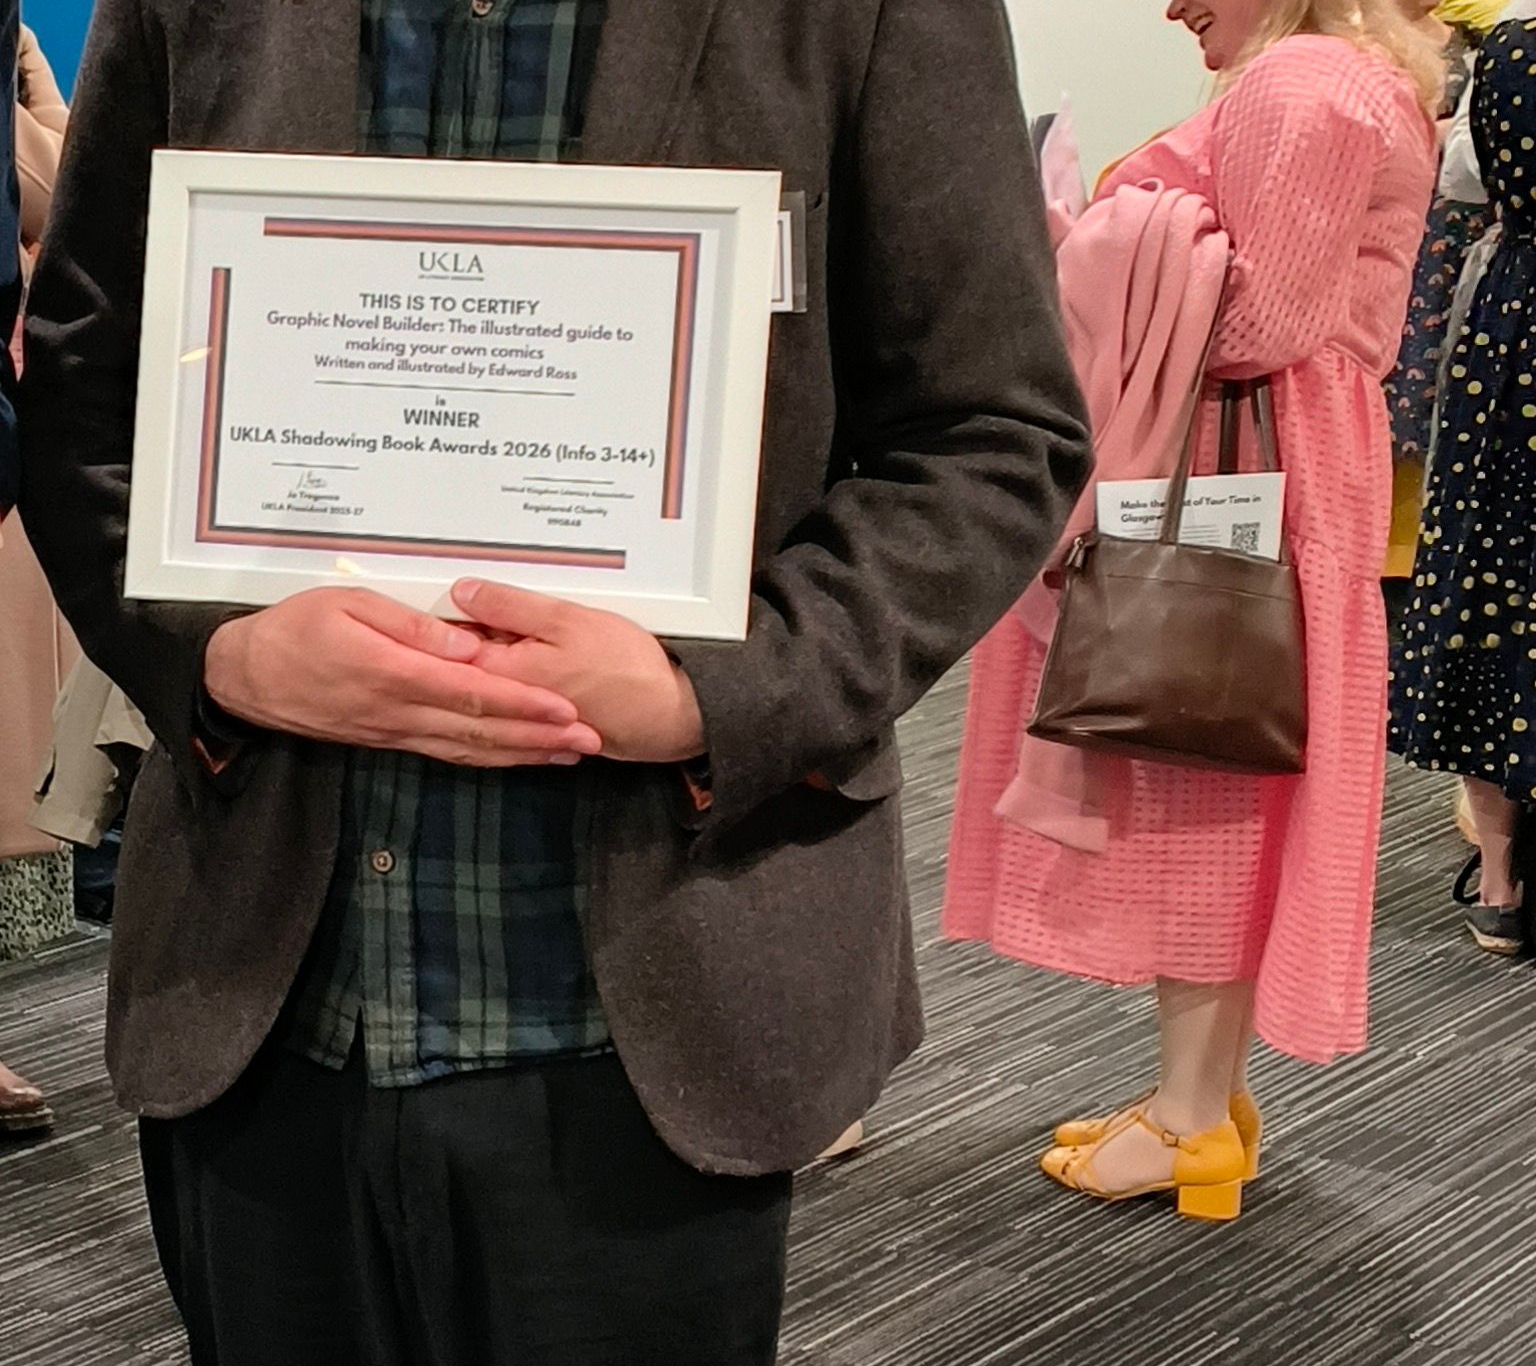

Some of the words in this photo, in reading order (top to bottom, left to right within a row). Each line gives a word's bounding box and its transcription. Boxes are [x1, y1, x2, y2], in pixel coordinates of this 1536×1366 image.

[419, 251, 484, 273] UKLA
[359, 293, 402, 310] THIS
[406, 295, 425, 312] IS
[430, 296, 456, 312] TO
[461, 297, 540, 316] CERTIFY
[267, 310, 330, 330] Graphic
[333, 313, 379, 330] Novel
[383, 316, 445, 333] Builder:
[448, 318, 477, 334] The
[480, 320, 563, 338] illustrated
[566, 325, 613, 343] guide
[616, 327, 634, 341] to
[345, 337, 406, 357] making
[409, 343, 447, 357] your
[450, 344, 487, 356] own
[490, 343, 545, 360] comics
[314, 354, 365, 370] Written
[367, 359, 394, 371] and
[397, 360, 465, 374] illustrated
[467, 362, 485, 379] by
[488, 363, 543, 379] Edward
[545, 366, 578, 380] Ross
[435, 395, 447, 407] is
[403, 408, 481, 428] WINNER
[229, 425, 276, 444] UKLA
[280, 429, 378, 453] Shadowing
[381, 435, 425, 452] Book
[428, 437, 498, 456] Awards
[502, 441, 552, 459] 2026
[555, 443, 597, 463] (Info
[600, 446, 657, 468] 3-14+)
[522, 501, 573, 514] Registered
[574, 504, 608, 518] Charity
[1120, 500, 1148, 510] Make
[1192, 496, 1205, 507] of
[1205, 496, 1227, 506] Your
[1228, 494, 1250, 505] Time
[1252, 494, 1262, 503] in
